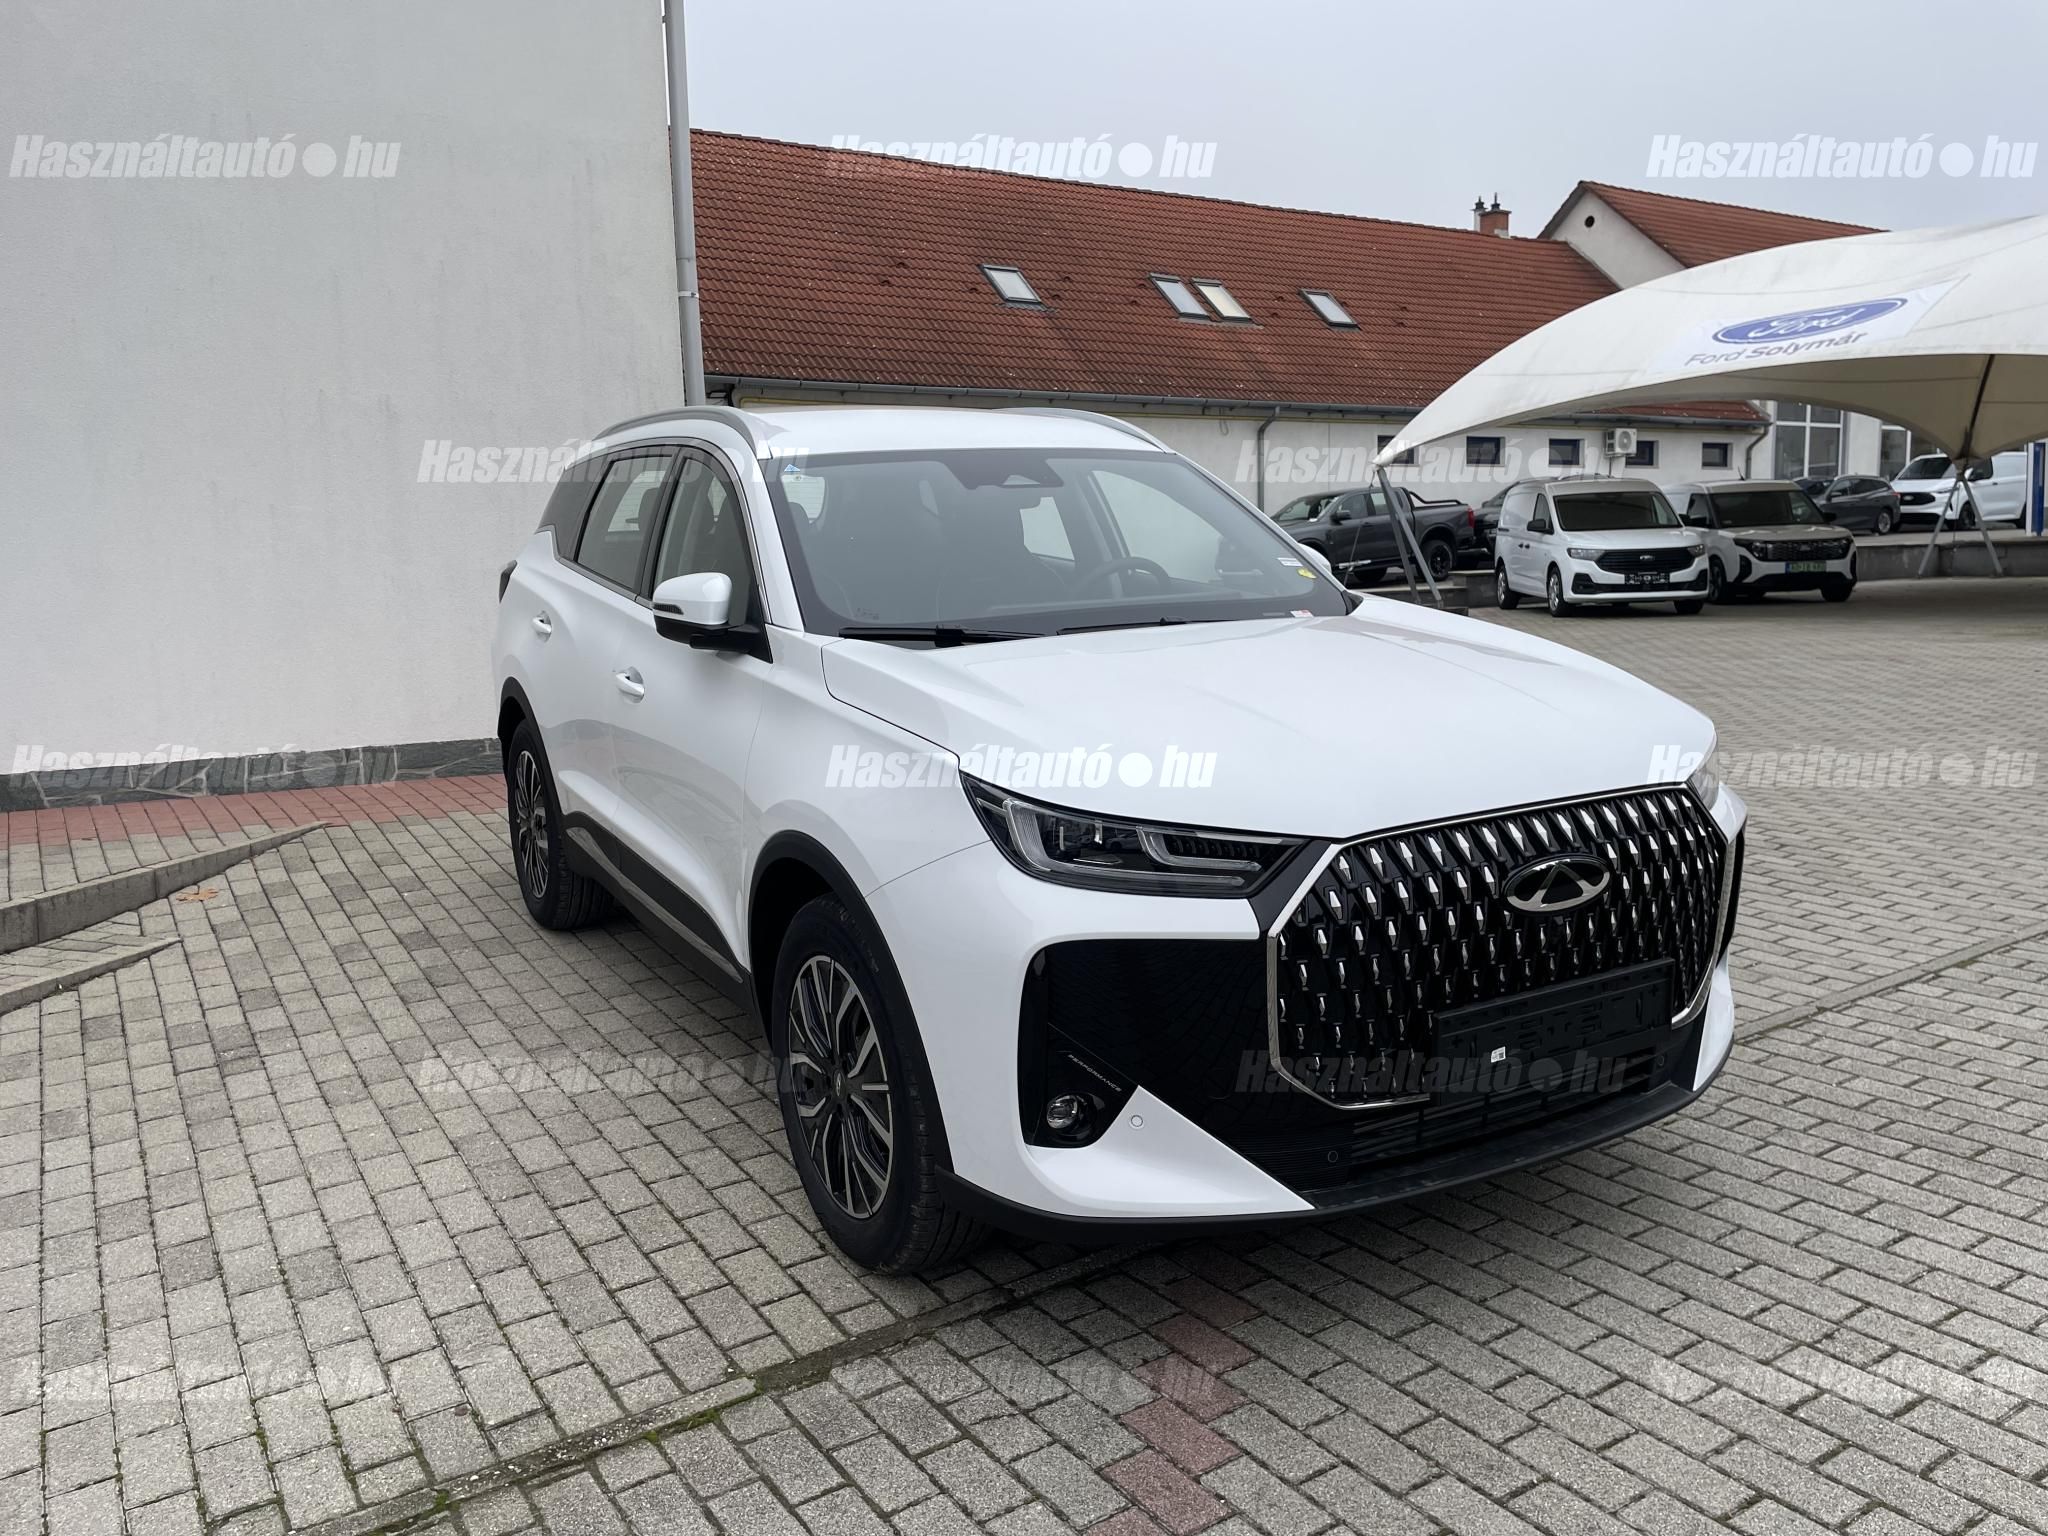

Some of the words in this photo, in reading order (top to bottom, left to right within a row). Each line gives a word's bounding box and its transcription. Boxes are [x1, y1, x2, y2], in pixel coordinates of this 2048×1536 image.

[1684, 349, 1746, 367] Ford
[1745, 330, 1869, 359] Solymár
[1068, 1054, 1123, 1092] PERFORMANCE
